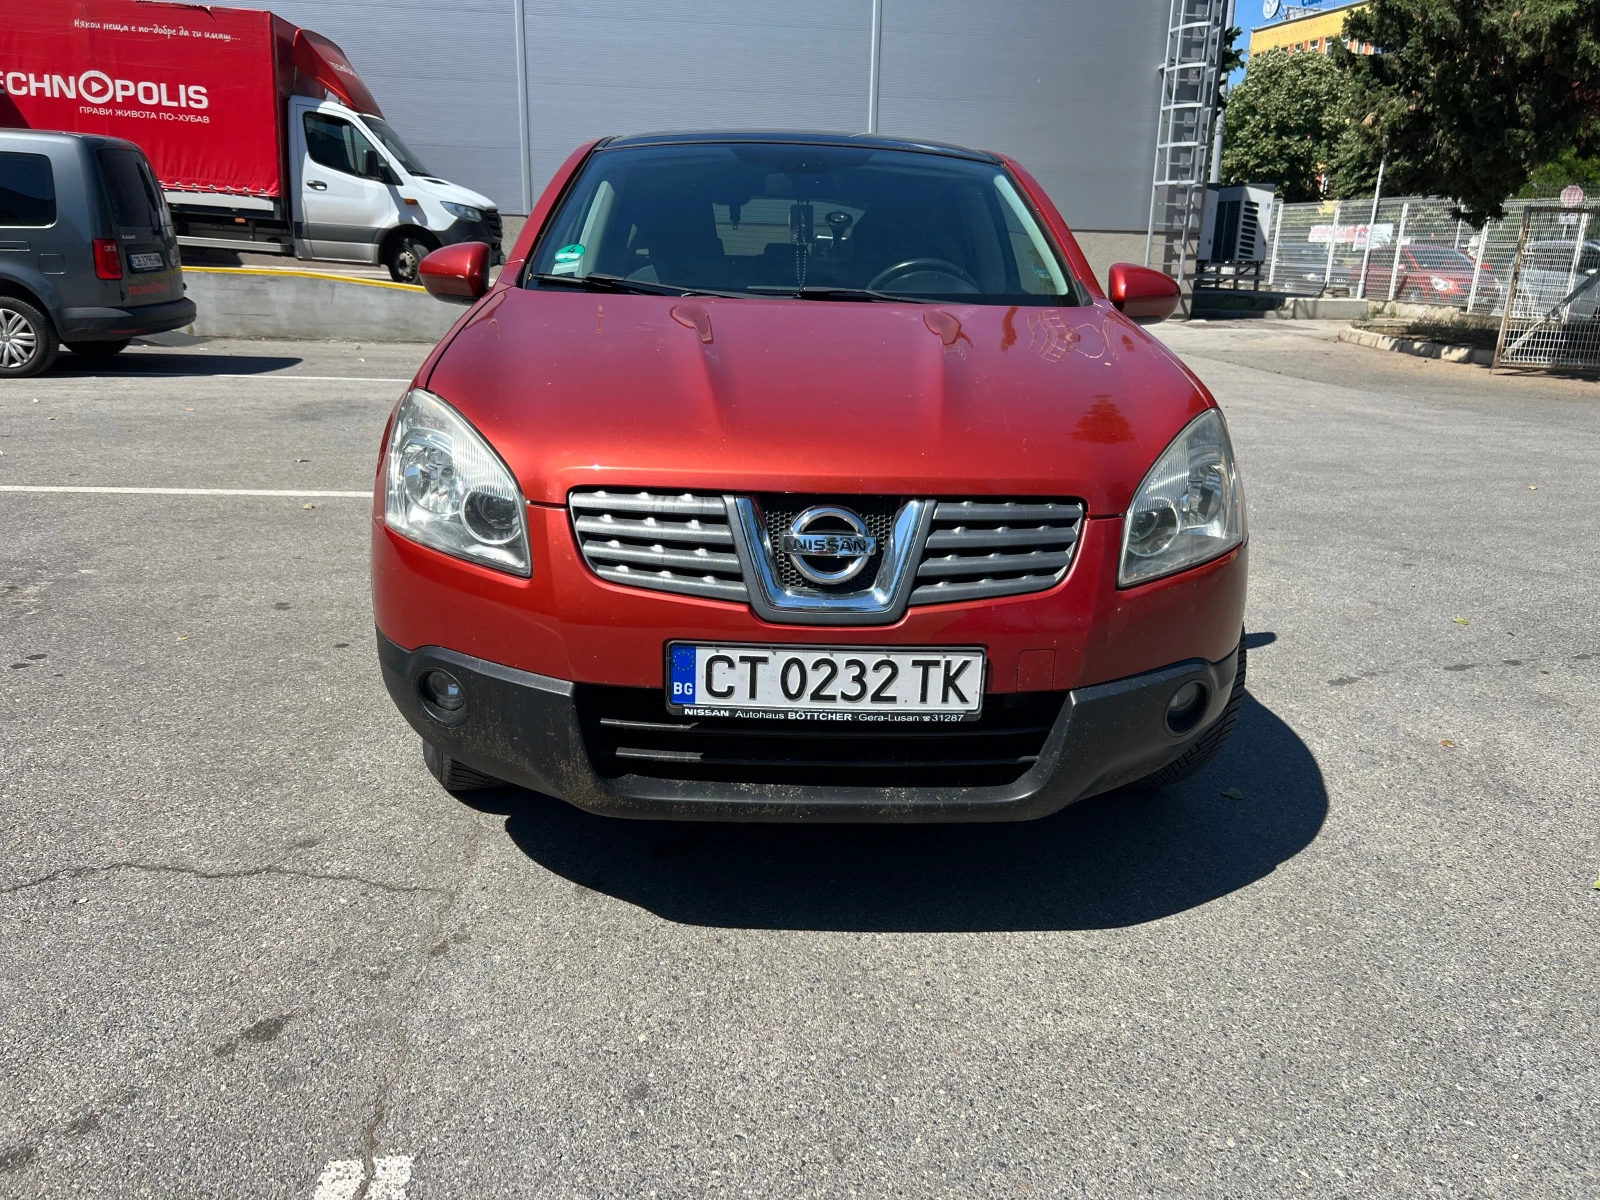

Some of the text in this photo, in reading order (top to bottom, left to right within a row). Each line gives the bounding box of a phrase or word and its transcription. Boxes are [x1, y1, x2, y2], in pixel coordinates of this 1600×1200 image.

[74, 18, 101, 29] Някои
[103, 22, 129, 32] неща
[138, 24, 177, 39] по-добре
[178, 26, 189, 37] да
[0, 70, 209, 110] CHNOPOLIS
[79, 106, 210, 124] ПРАВИ ЖИВОТА ПО-ХУБАВ
[566, 245, 577, 254] 4
[793, 538, 867, 552] NISSAN
[704, 654, 972, 704] CT 0232 TK
[673, 682, 693, 696] BG
[684, 708, 964, 722] NISSAN Autohaus BÖTTCHER Gera-Lusan 31287
